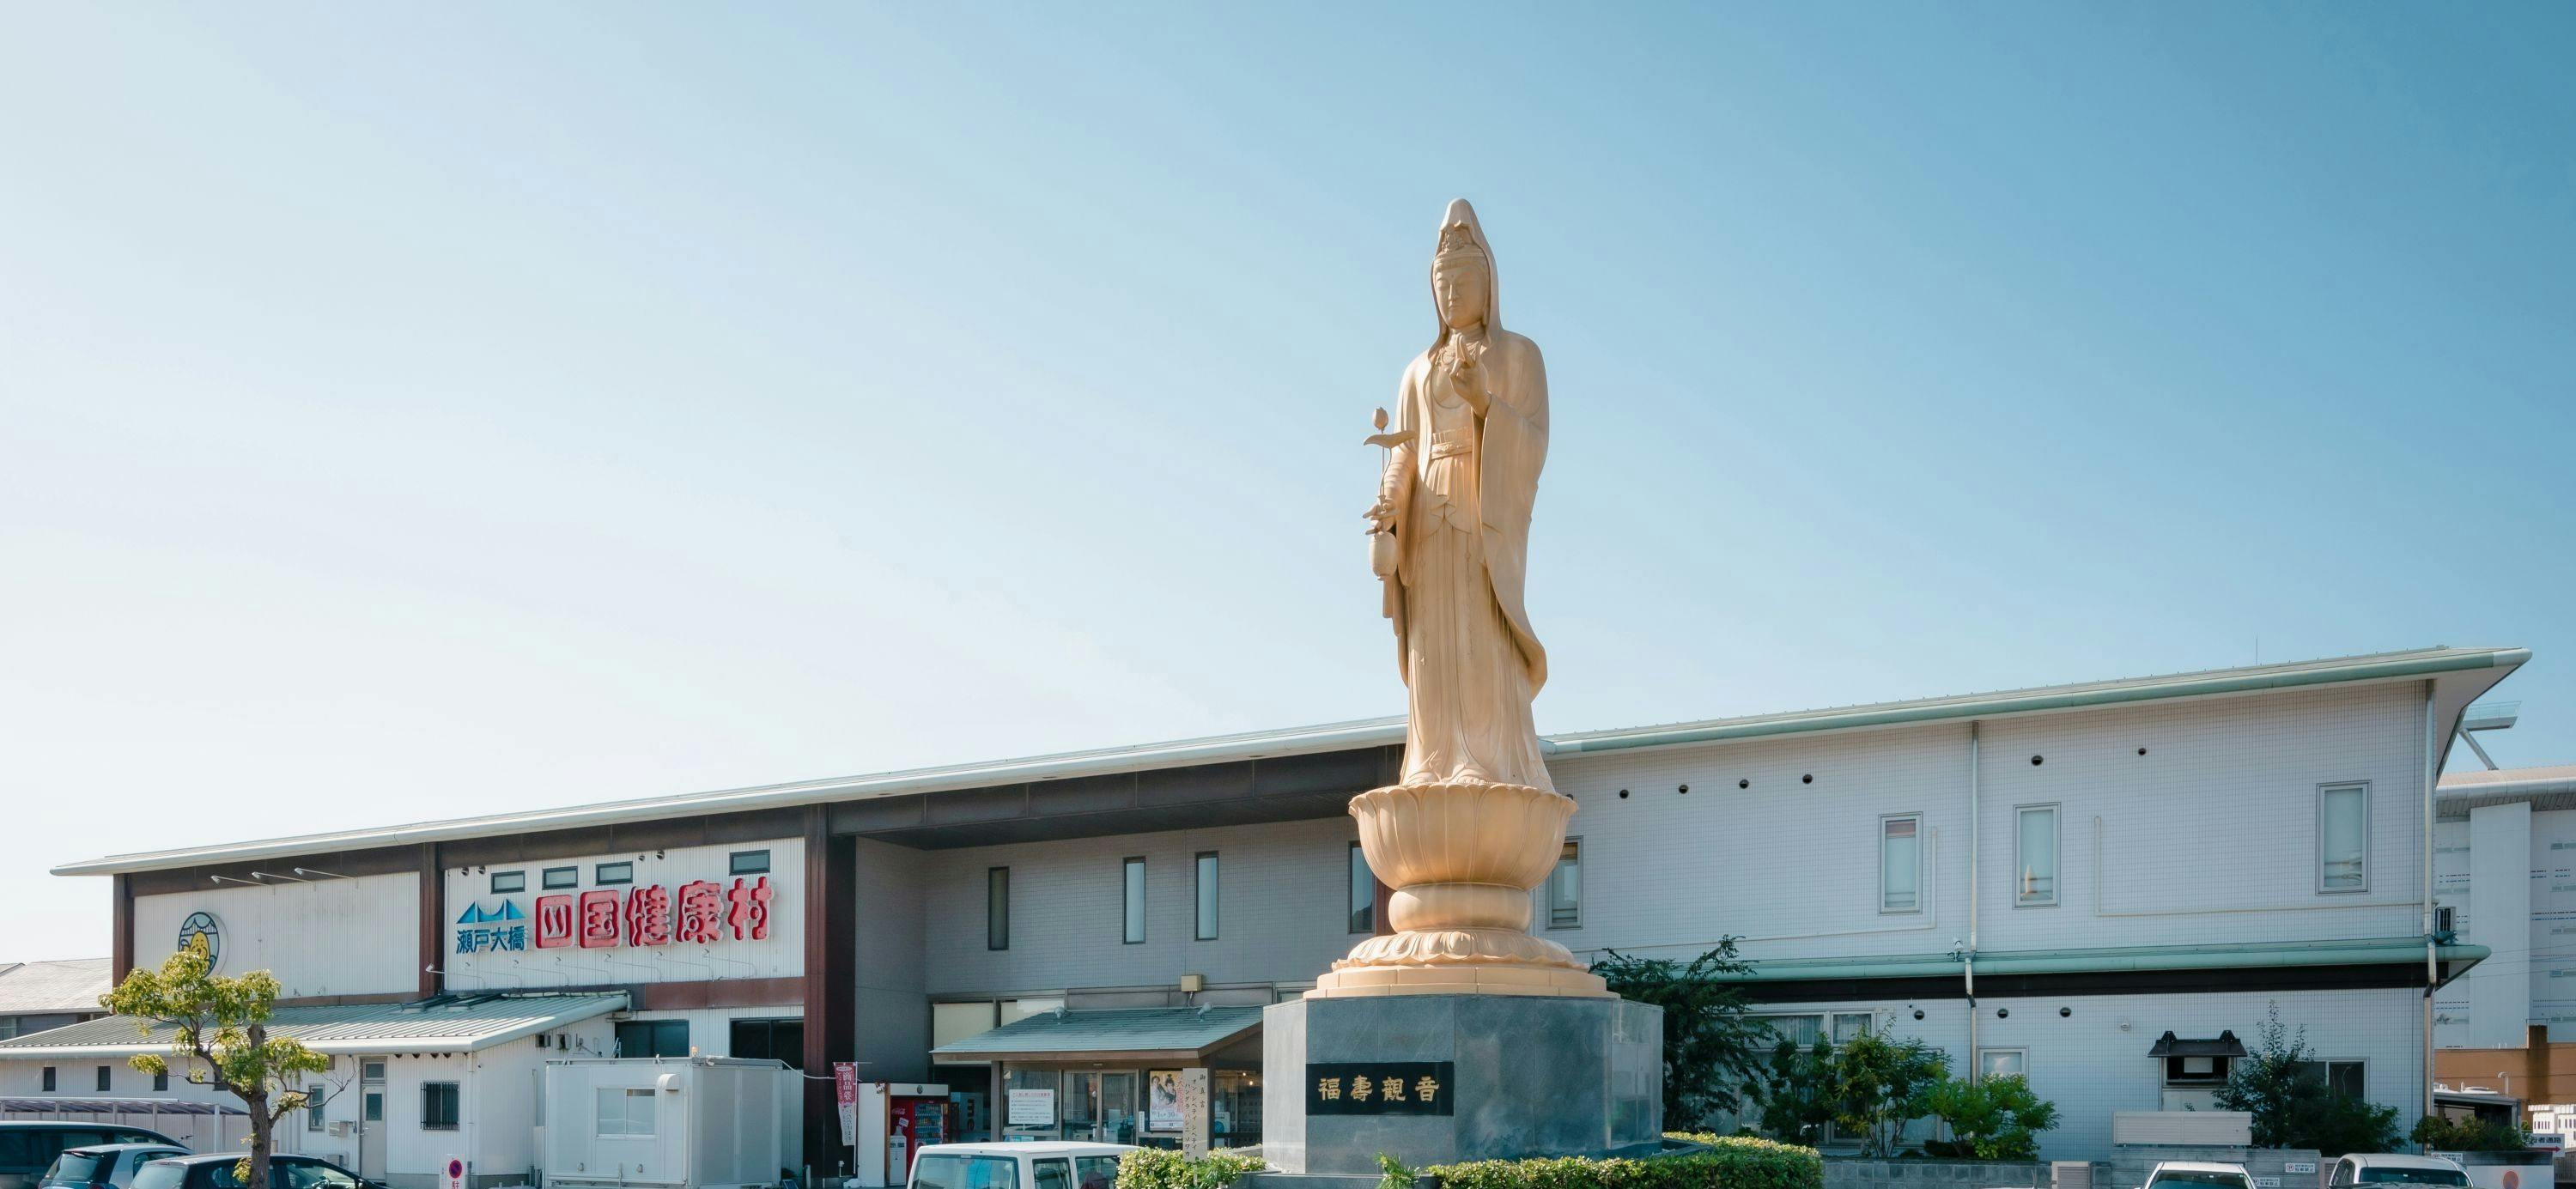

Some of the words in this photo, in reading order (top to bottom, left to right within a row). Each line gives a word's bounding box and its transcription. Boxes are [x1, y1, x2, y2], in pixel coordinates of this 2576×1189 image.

[535, 876, 773, 949] 四国健康村
[456, 925, 525, 954] 瀬戸大橋
